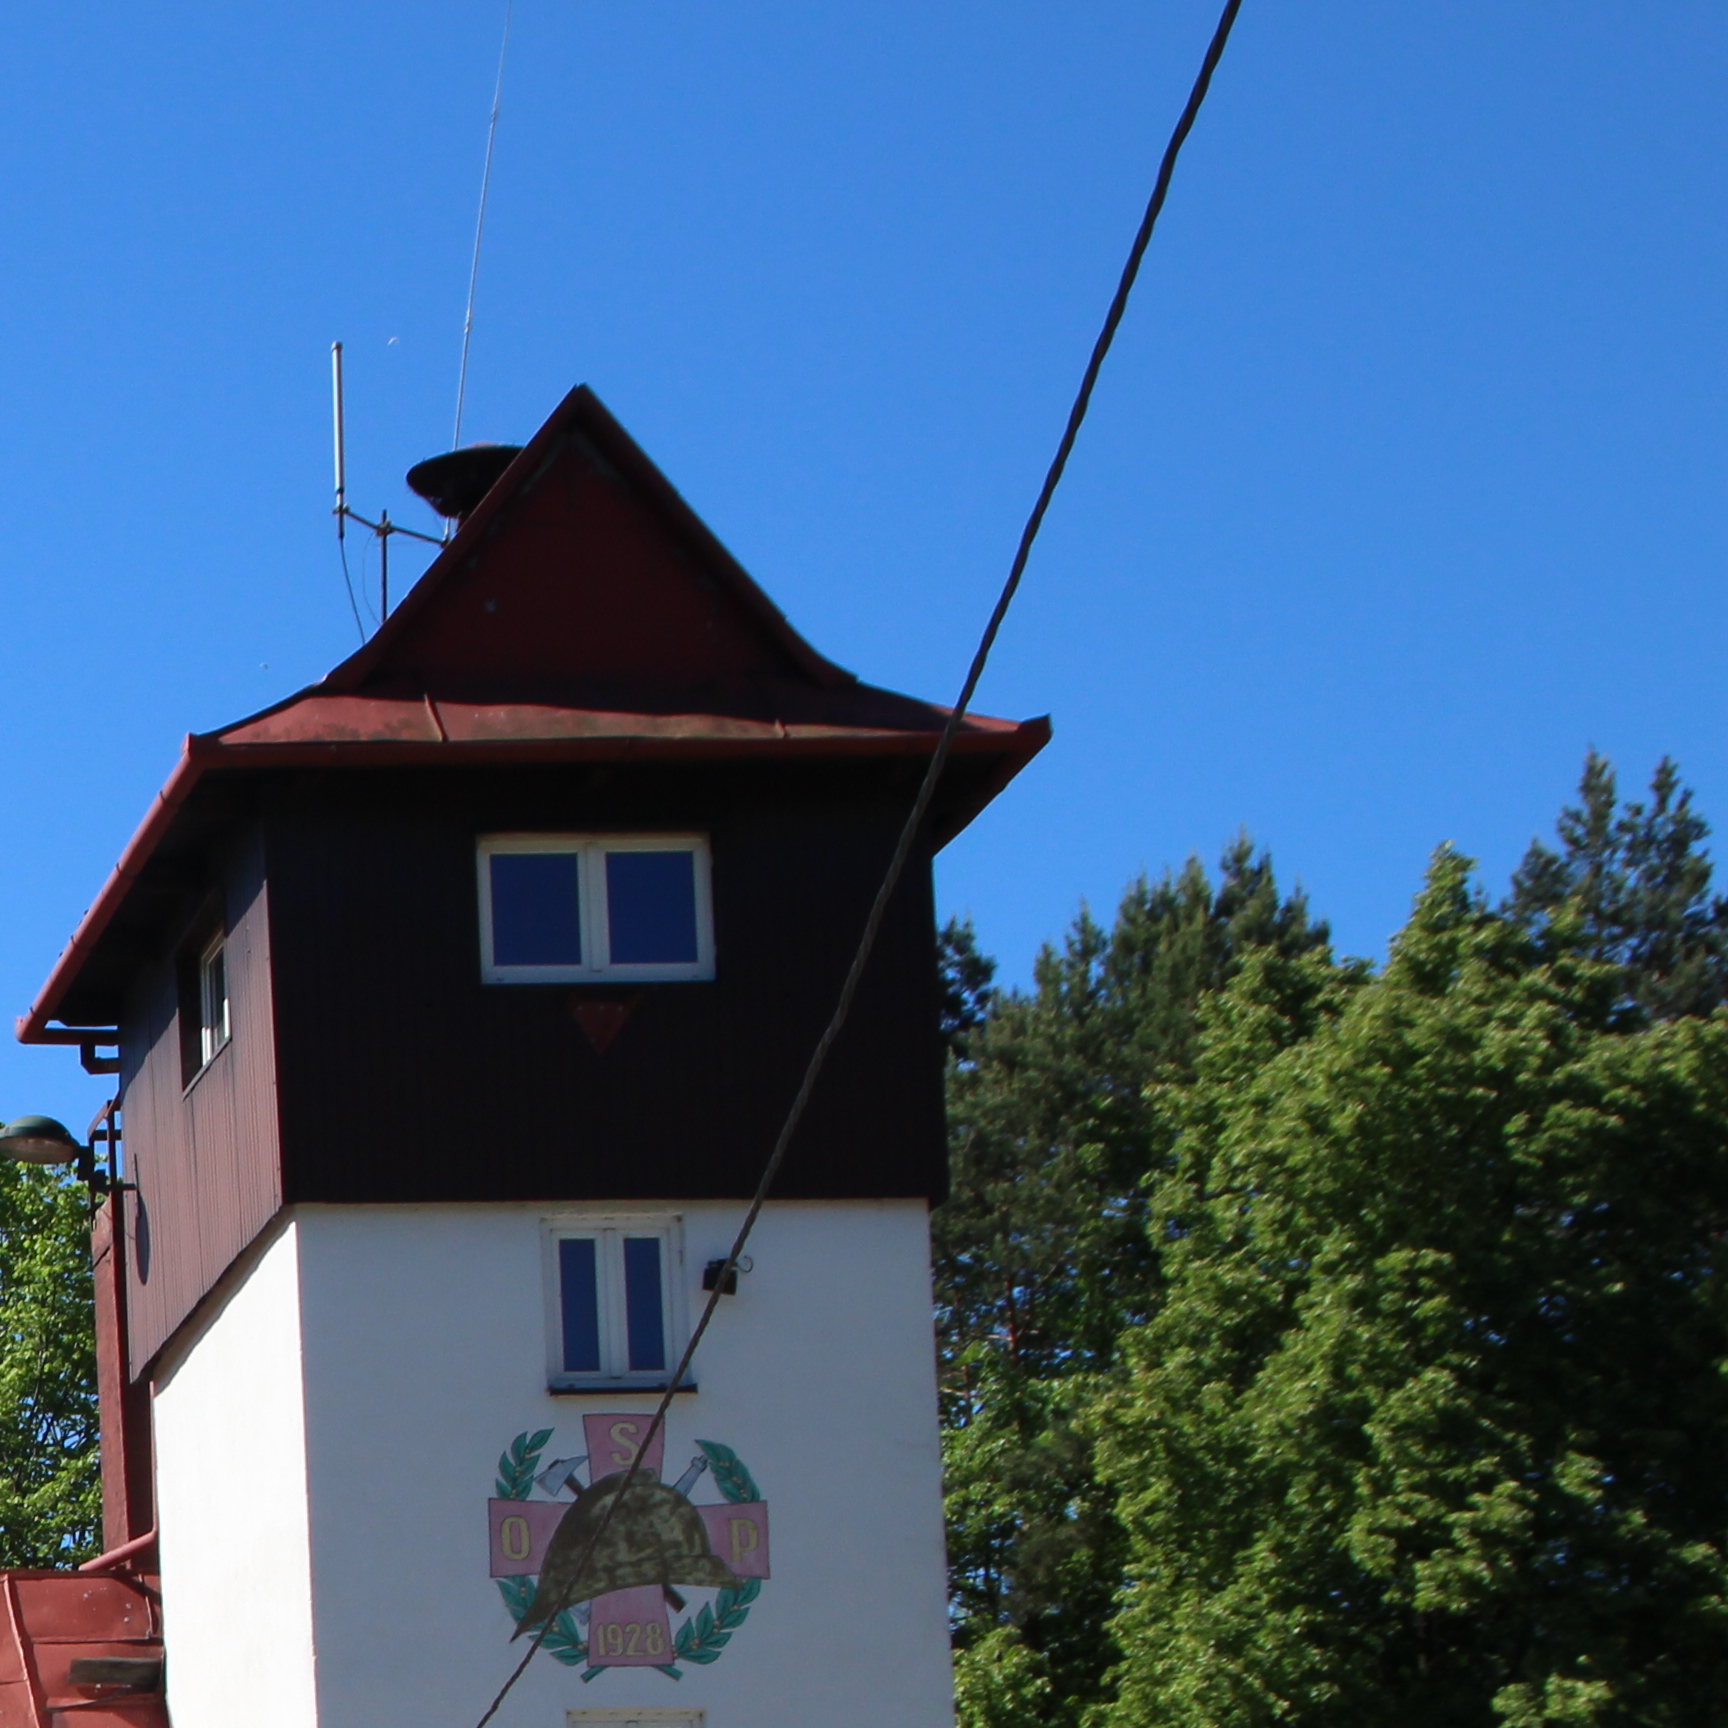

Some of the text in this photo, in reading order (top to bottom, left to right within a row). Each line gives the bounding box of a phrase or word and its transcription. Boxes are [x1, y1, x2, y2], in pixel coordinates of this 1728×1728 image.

[608, 1421, 641, 1467] S
[728, 1518, 759, 1564] P
[595, 1622, 666, 1658] 1928
